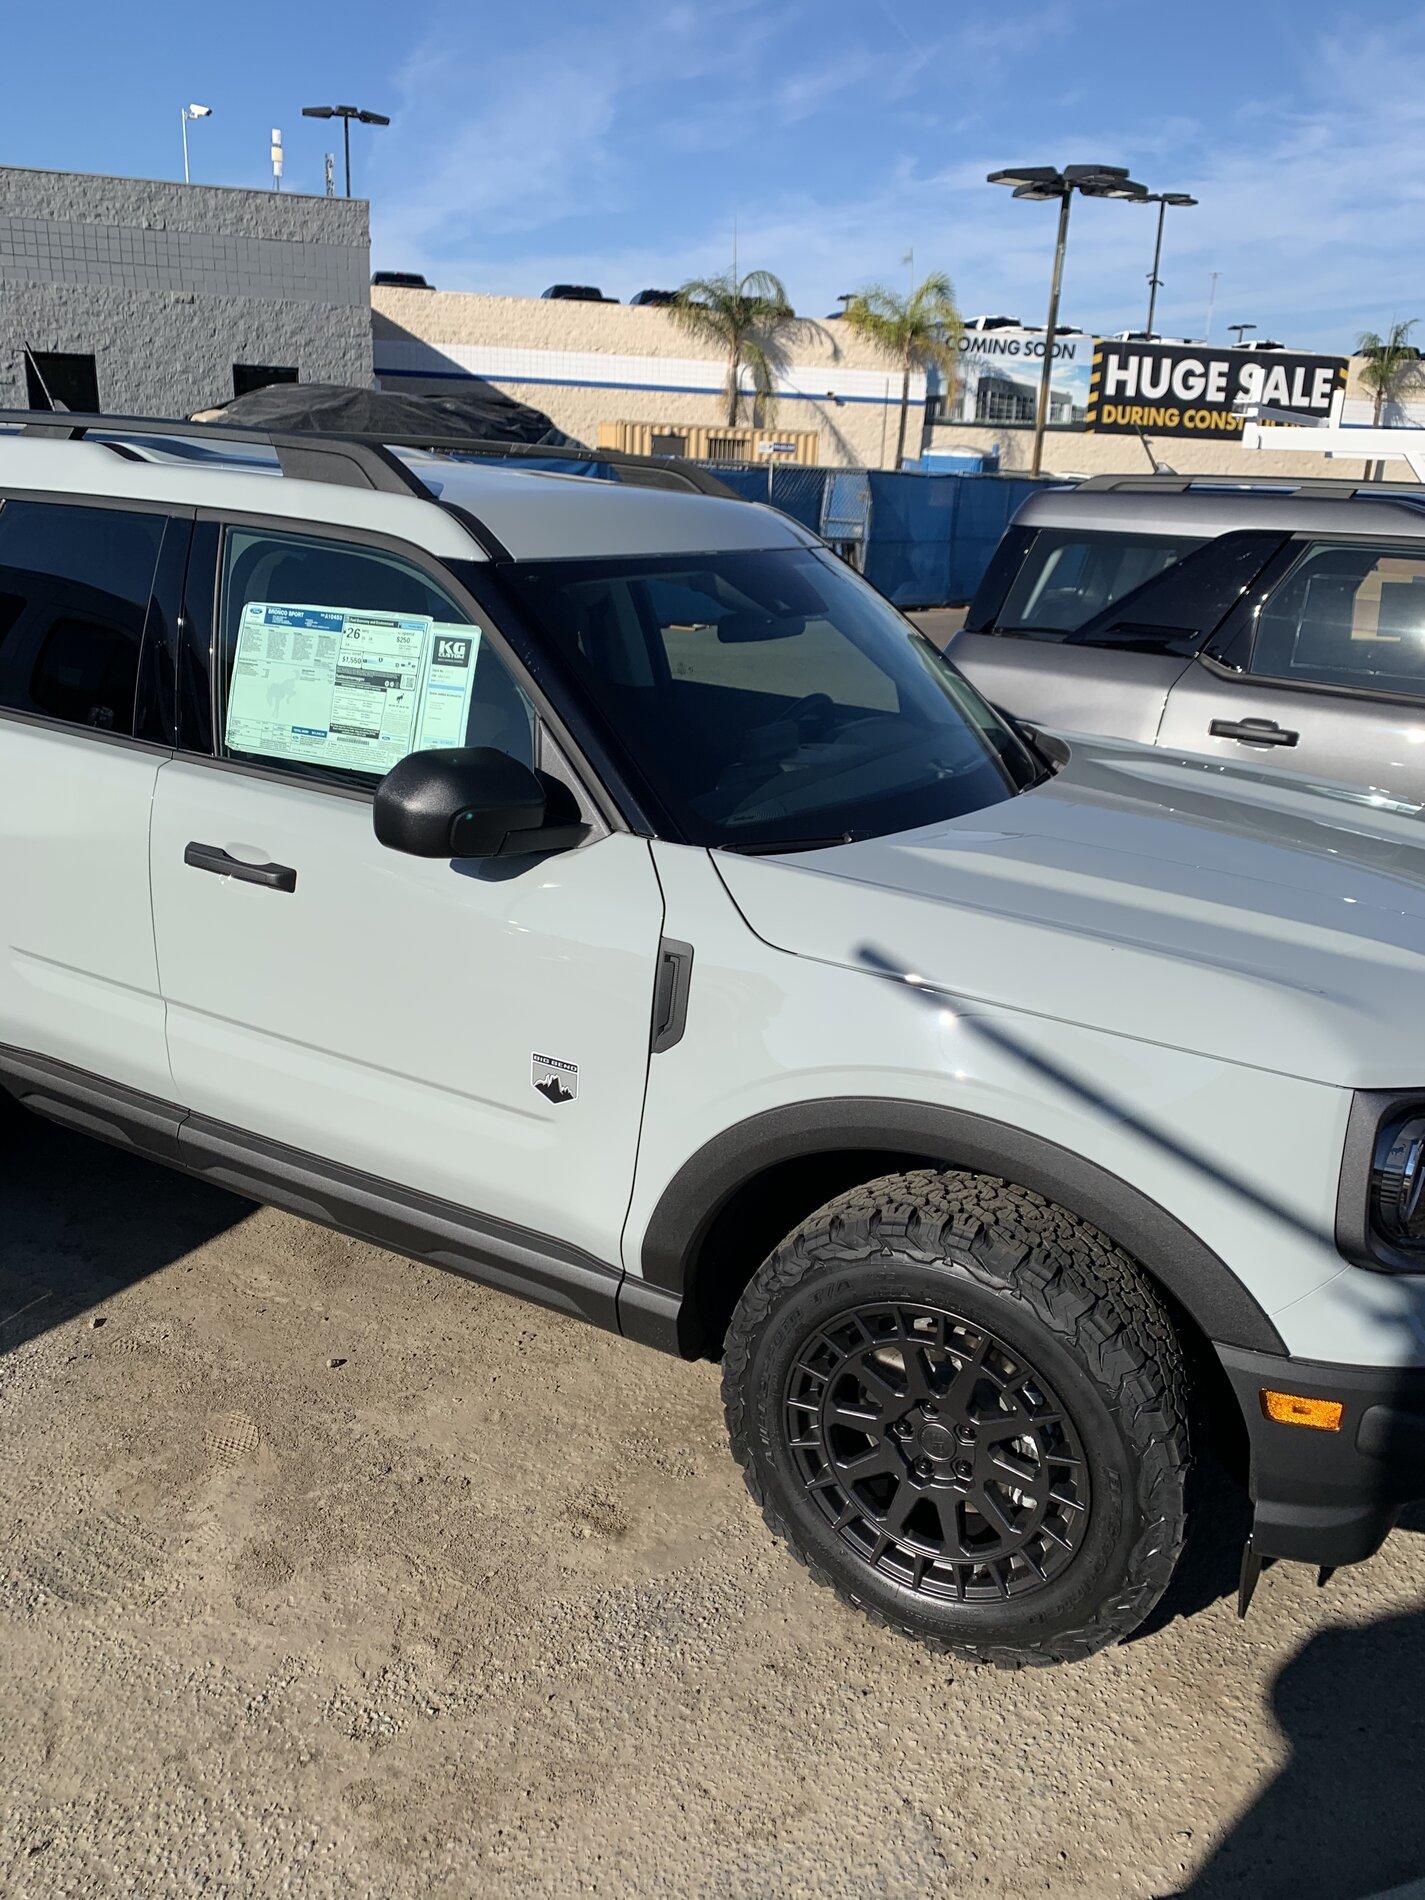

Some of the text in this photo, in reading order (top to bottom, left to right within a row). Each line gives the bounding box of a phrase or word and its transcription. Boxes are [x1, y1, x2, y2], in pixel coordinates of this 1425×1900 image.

[946, 336, 1076, 359] COMING SOON
[1105, 353, 1334, 408] HUGE SALE
[1101, 404, 1180, 427] DURING
[268, 608, 288, 616] BRONCO
[288, 610, 304, 618] SPORT
[346, 627, 361, 640] 26
[396, 636, 411, 644] $250
[439, 640, 466, 655] KG
[533, 1055, 577, 1072] BIG BEND
